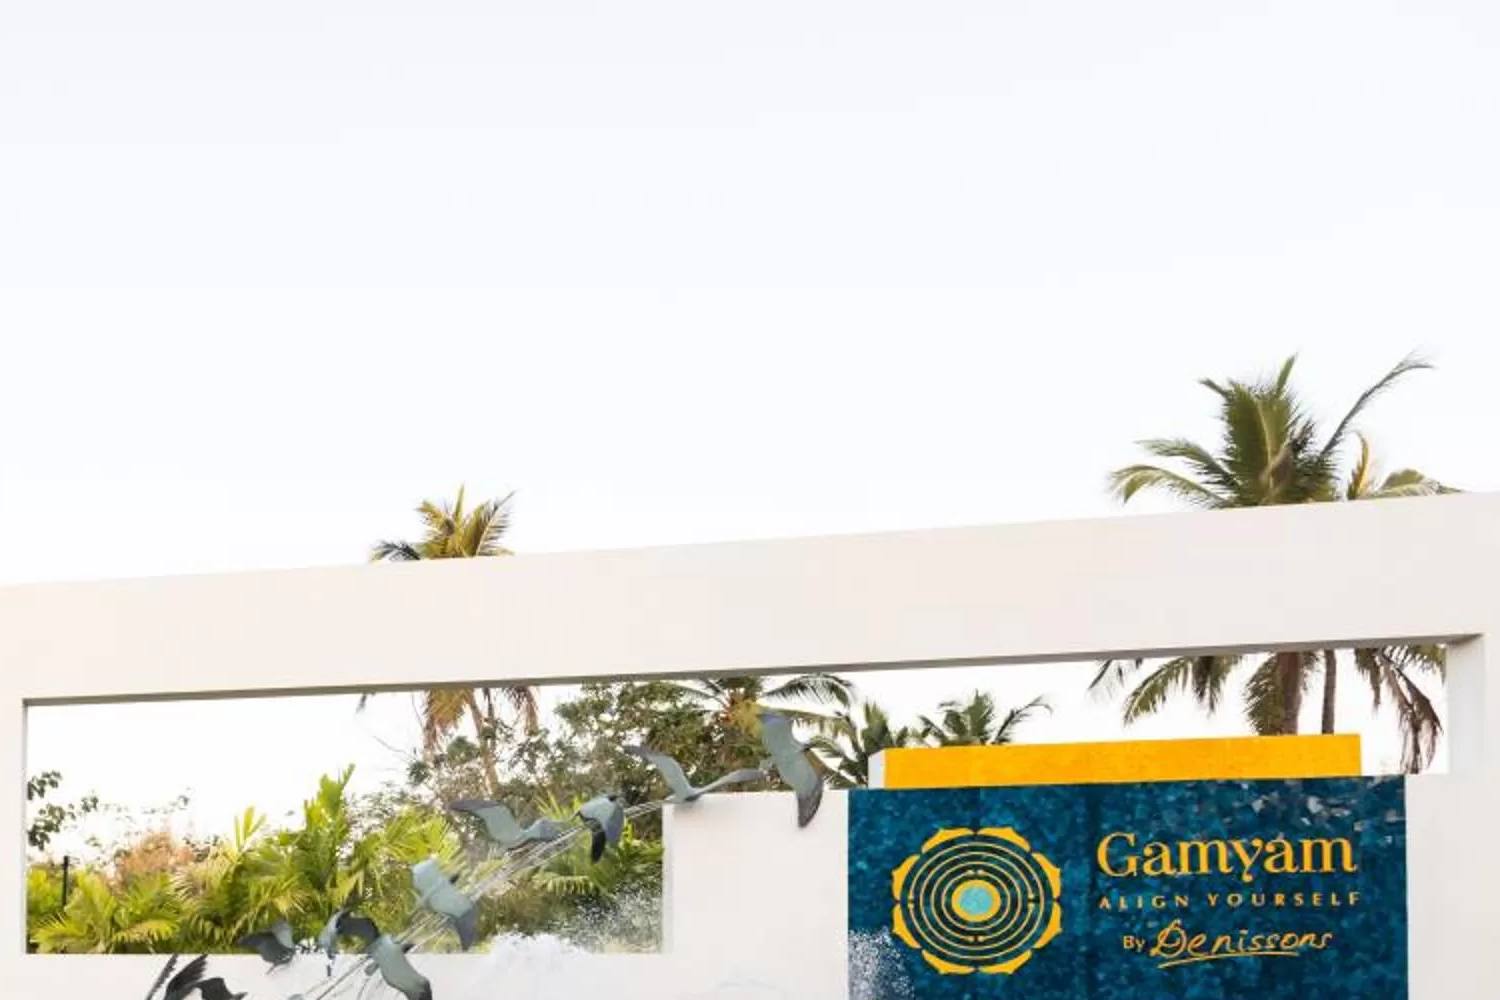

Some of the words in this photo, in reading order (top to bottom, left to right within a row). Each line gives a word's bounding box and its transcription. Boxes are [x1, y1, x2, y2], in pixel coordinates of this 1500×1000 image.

[1097, 831, 1358, 882] Gamyam
[1099, 894, 1189, 911] ALIGN
[1207, 891, 1361, 908] YOURSELF
[1123, 935, 1145, 952] By
